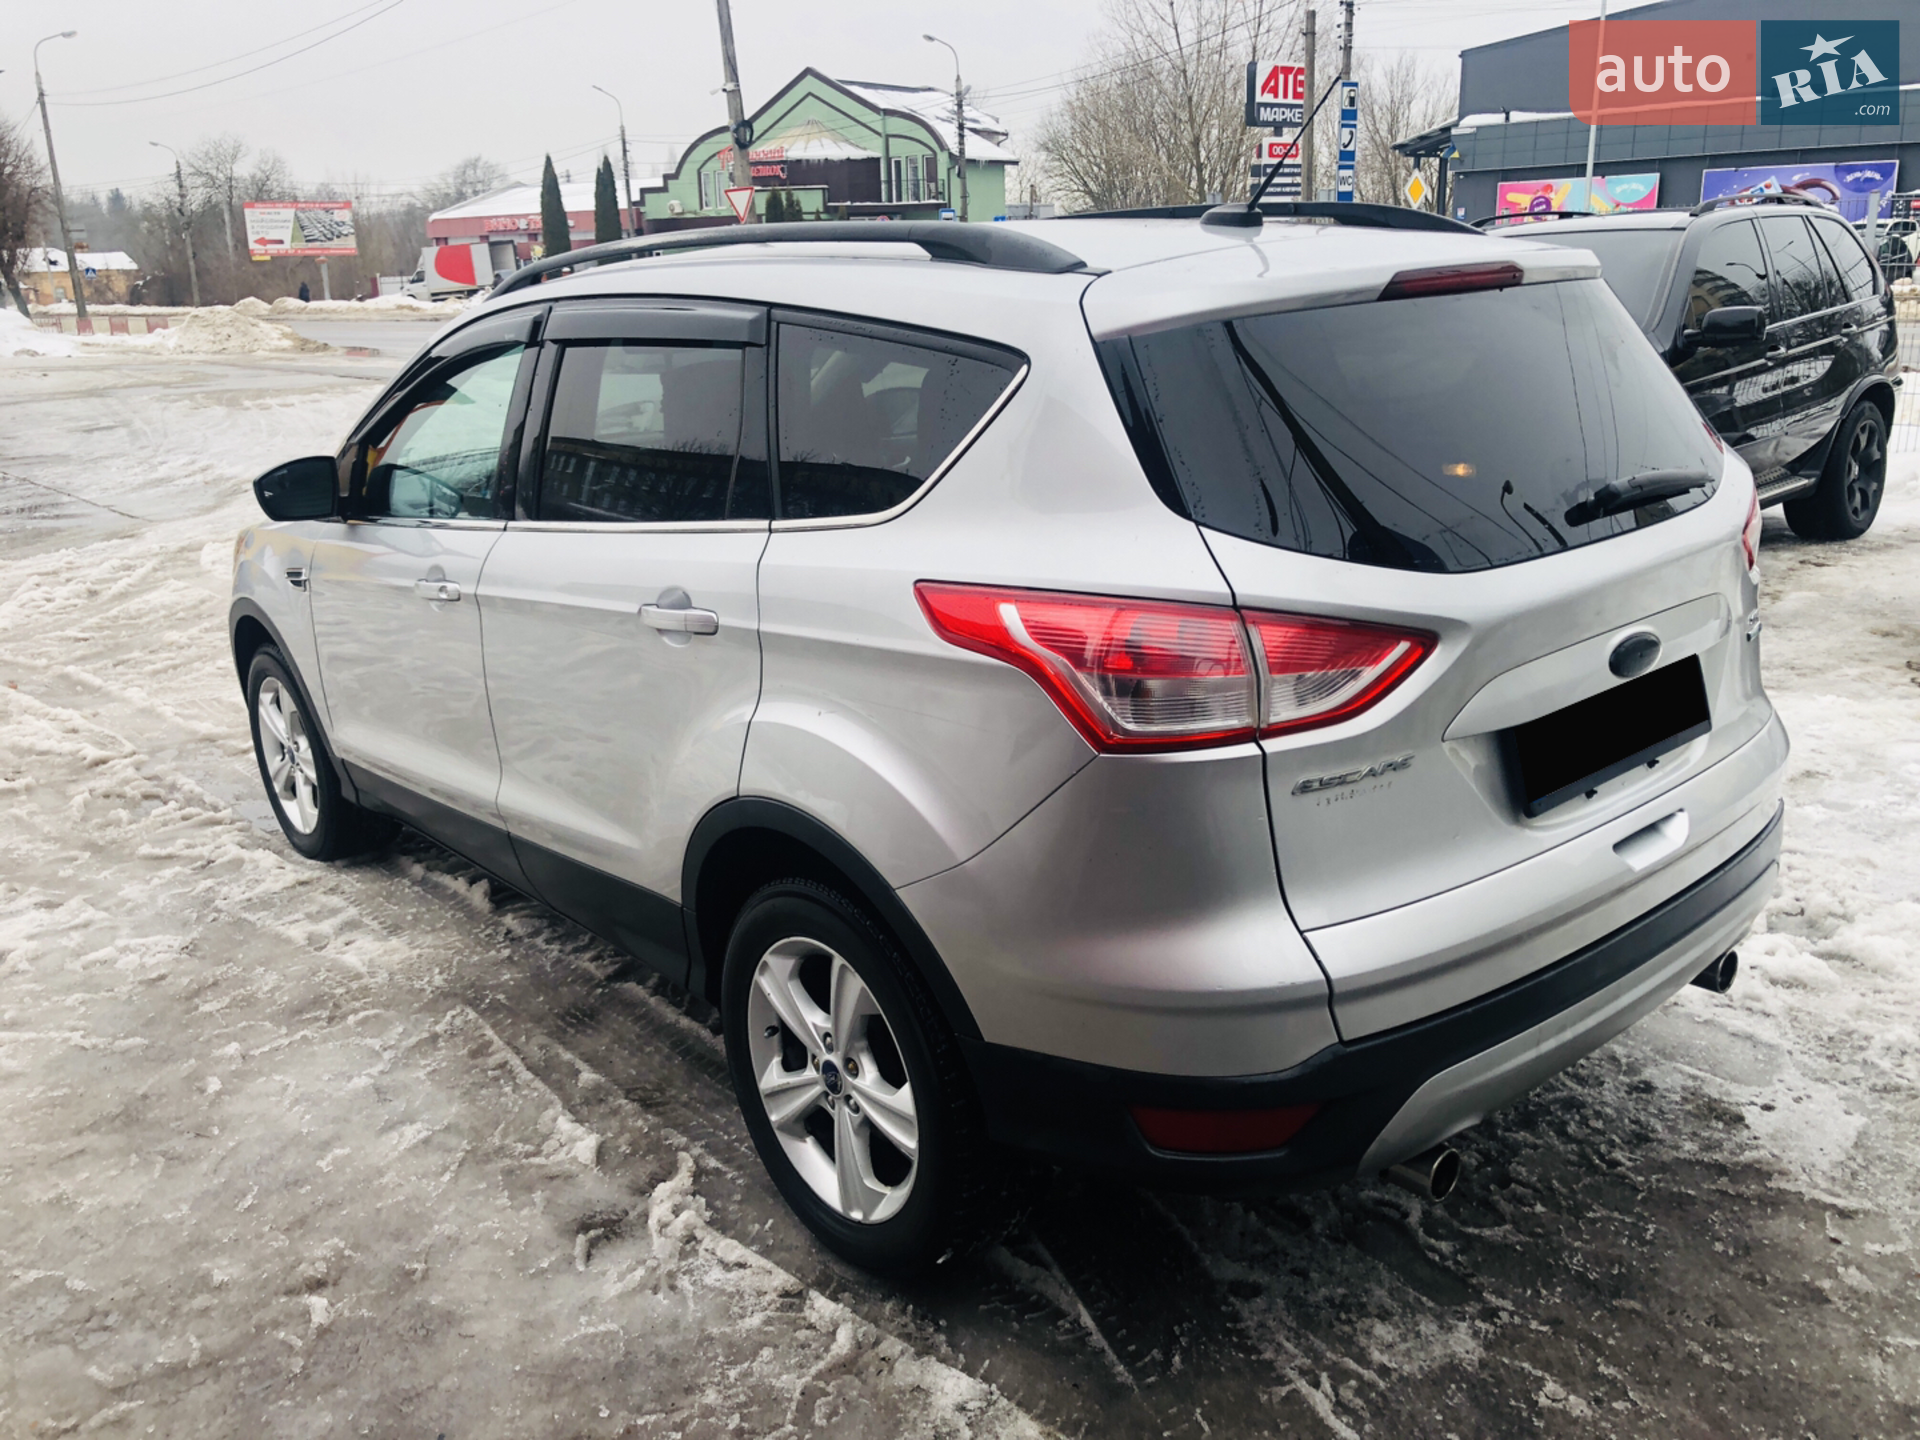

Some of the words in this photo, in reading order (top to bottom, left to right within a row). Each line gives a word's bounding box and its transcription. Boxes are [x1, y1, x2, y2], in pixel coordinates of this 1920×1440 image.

[1260, 106, 1304, 123] МАРКЕ
[1340, 175, 1354, 187] WC
[1291, 751, 1416, 796] ESCAPE
